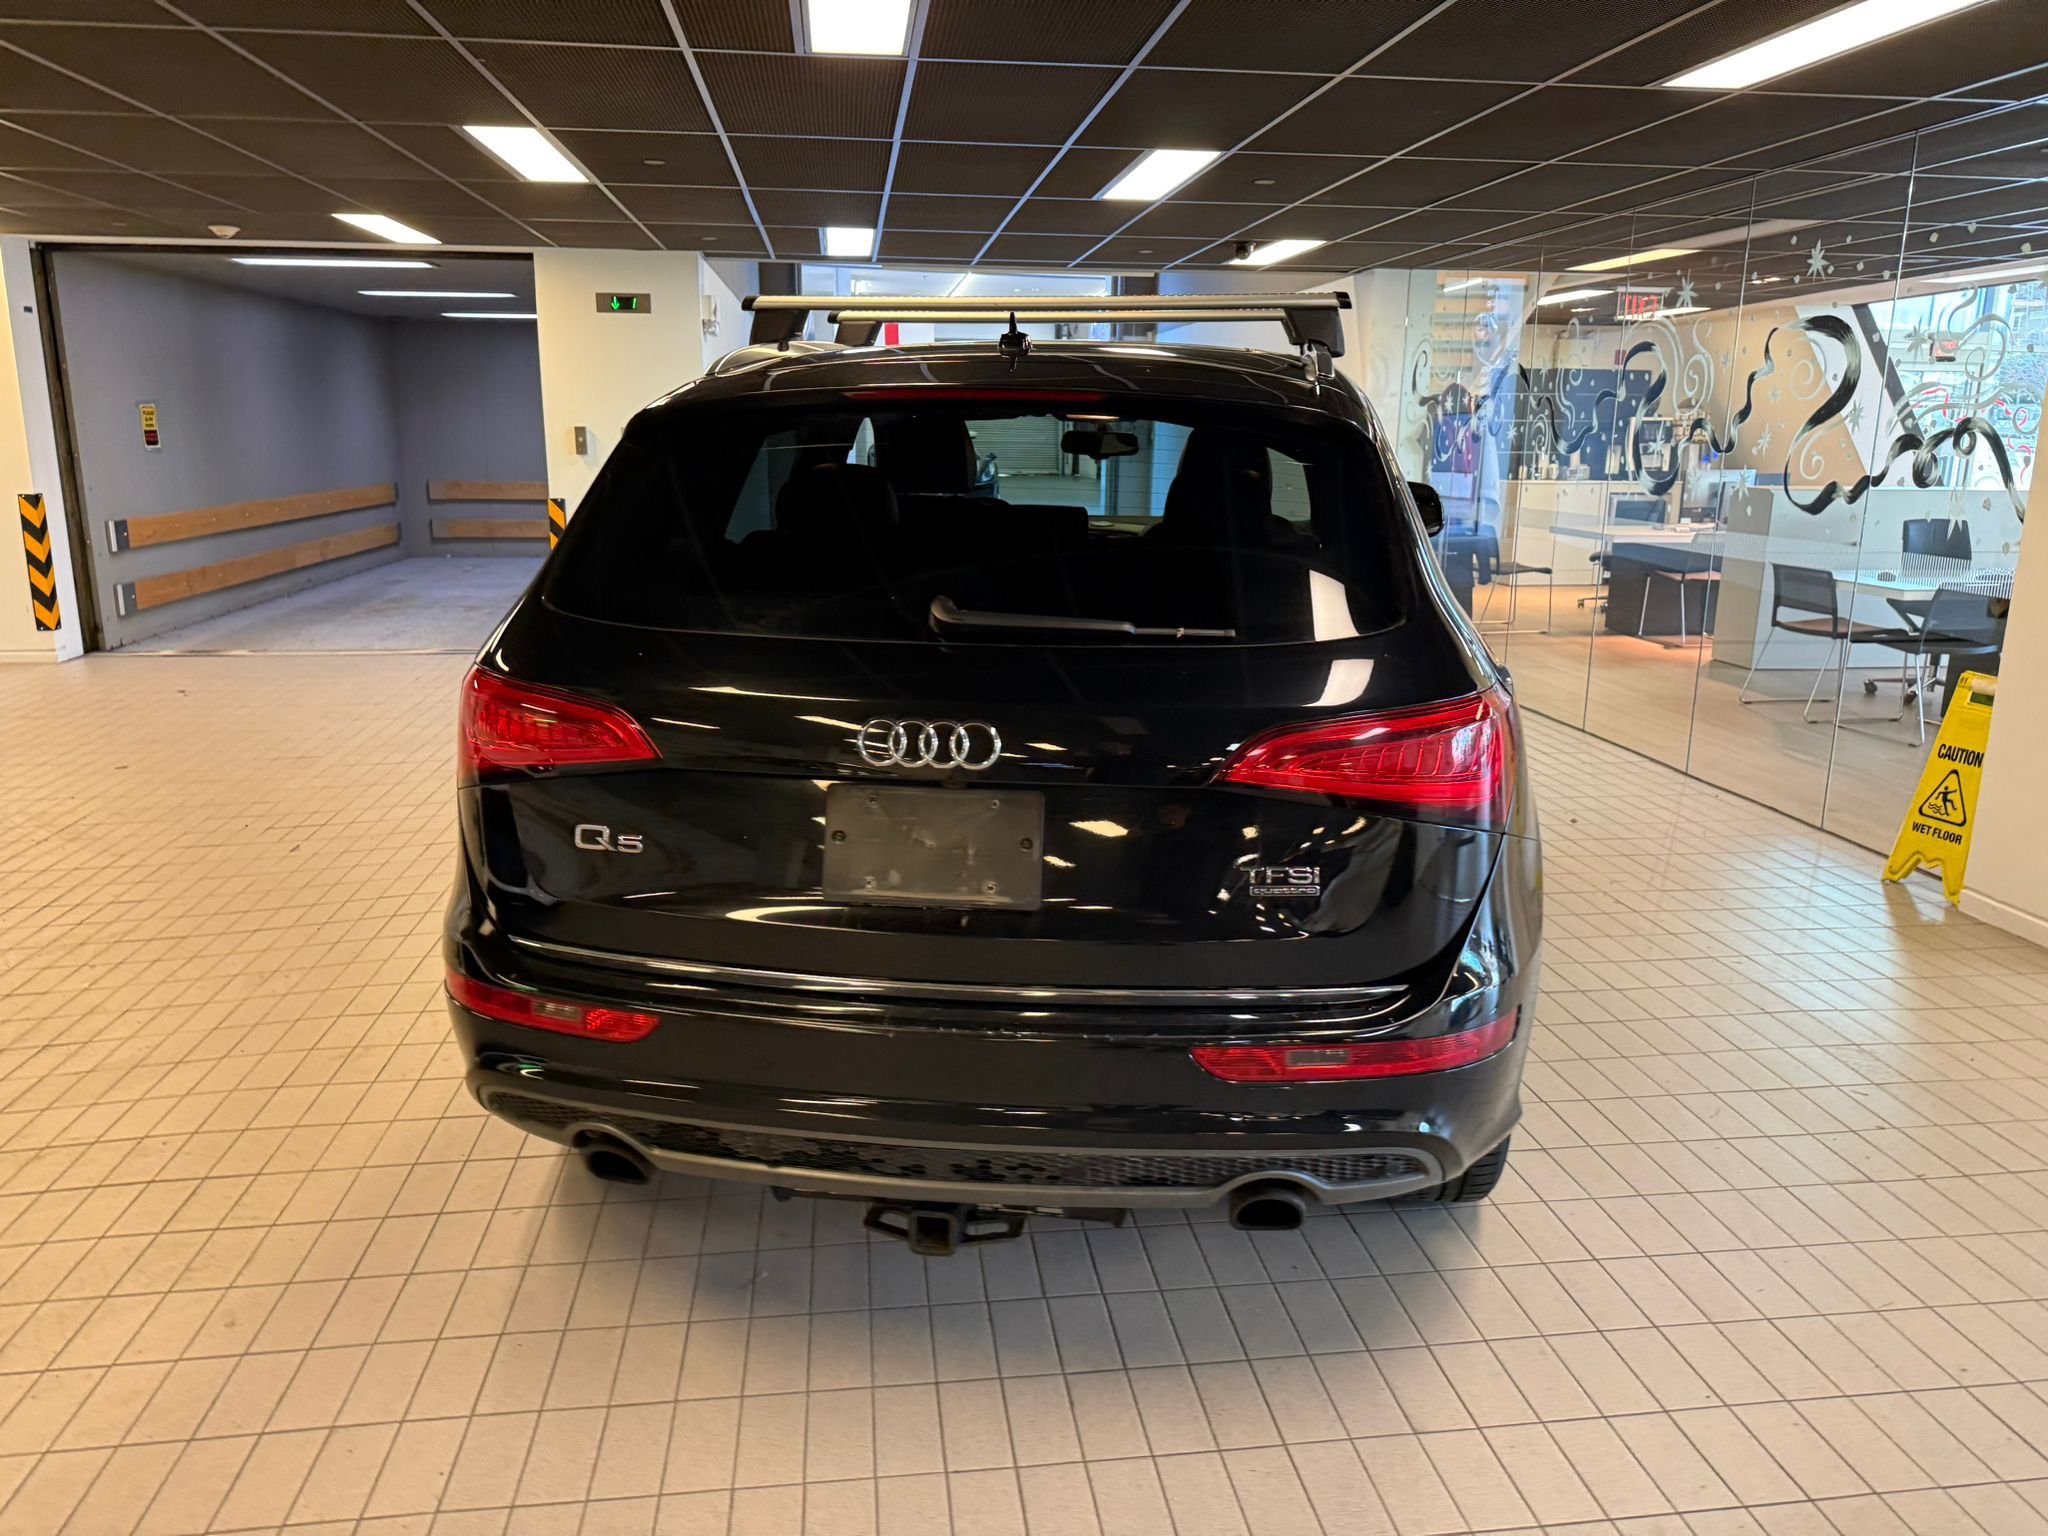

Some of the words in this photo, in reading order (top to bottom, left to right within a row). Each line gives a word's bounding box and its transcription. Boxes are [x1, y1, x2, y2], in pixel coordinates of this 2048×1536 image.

[1937, 743, 1984, 768] CAUTION
[575, 823, 643, 853] Q5
[1912, 821, 1932, 836] WET
[1932, 827, 1962, 845] FLOOR
[1252, 887, 1317, 895] quattro
